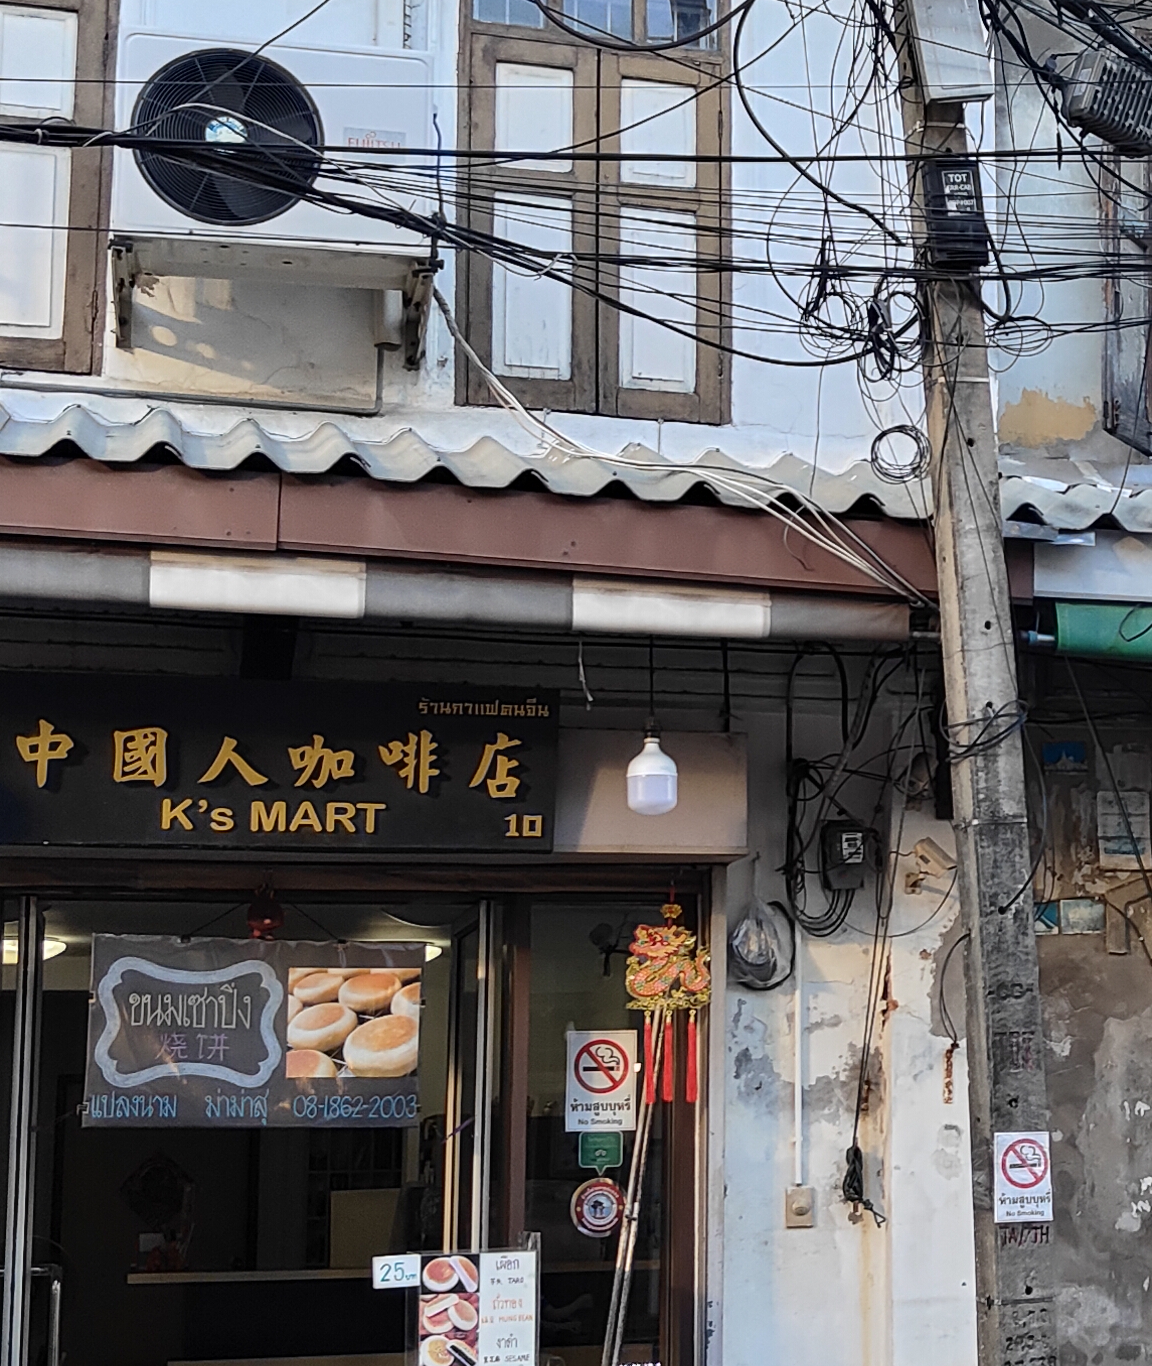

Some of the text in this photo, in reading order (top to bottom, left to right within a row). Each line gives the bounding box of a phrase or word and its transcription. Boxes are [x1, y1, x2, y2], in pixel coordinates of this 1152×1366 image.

[948, 174, 967, 183] TOT
[16, 719, 522, 799] 中國人咖啡店
[250, 800, 387, 833] MART
[293, 1094, 418, 1119] 08-1862-2003
[570, 1094, 632, 1116] ห้ามสูบบุหรี่
[590, 1118, 623, 1126] Smoking
[999, 1188, 1051, 1209] ห้ามสูบบุหรี่
[380, 1262, 405, 1283] 25
[505, 1354, 530, 1363] SESAME
